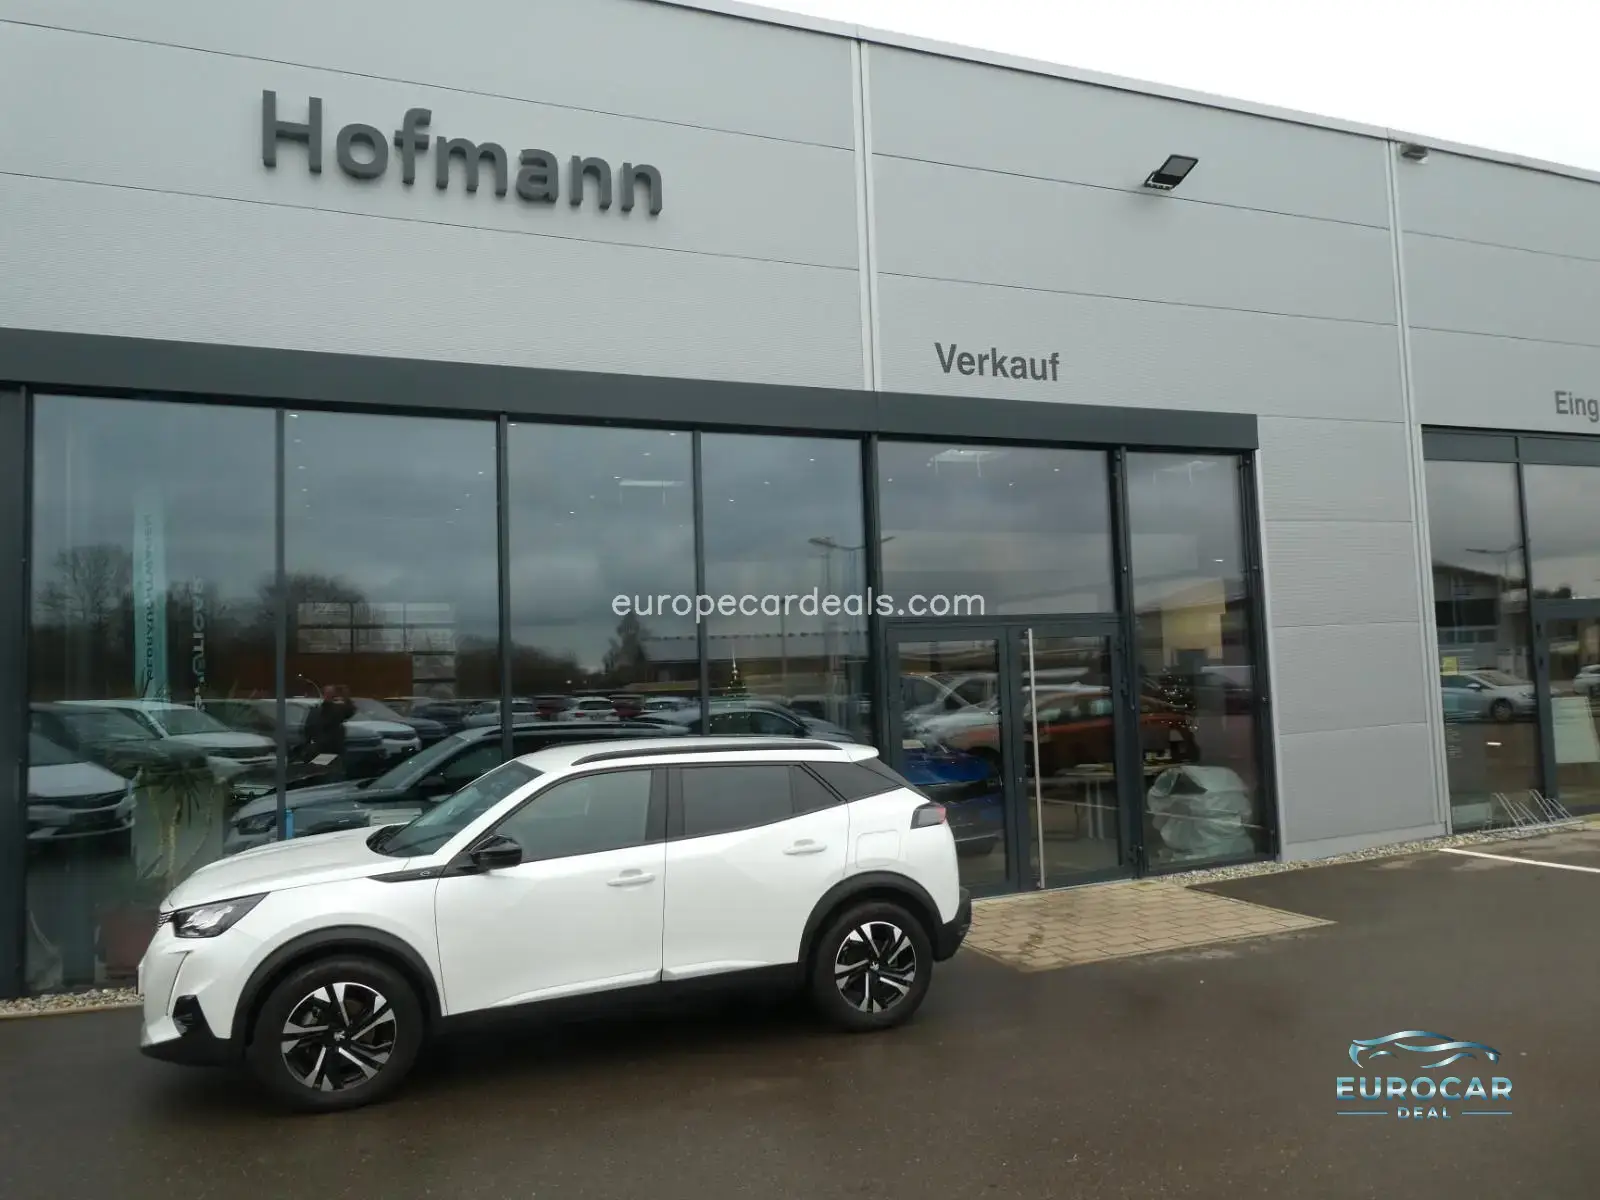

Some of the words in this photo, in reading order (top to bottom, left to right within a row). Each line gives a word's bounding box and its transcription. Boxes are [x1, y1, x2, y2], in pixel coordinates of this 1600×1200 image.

[262, 89, 663, 215] Hofmann
[934, 342, 1060, 381] Verkauf
[1555, 390, 1600, 423] Eing
